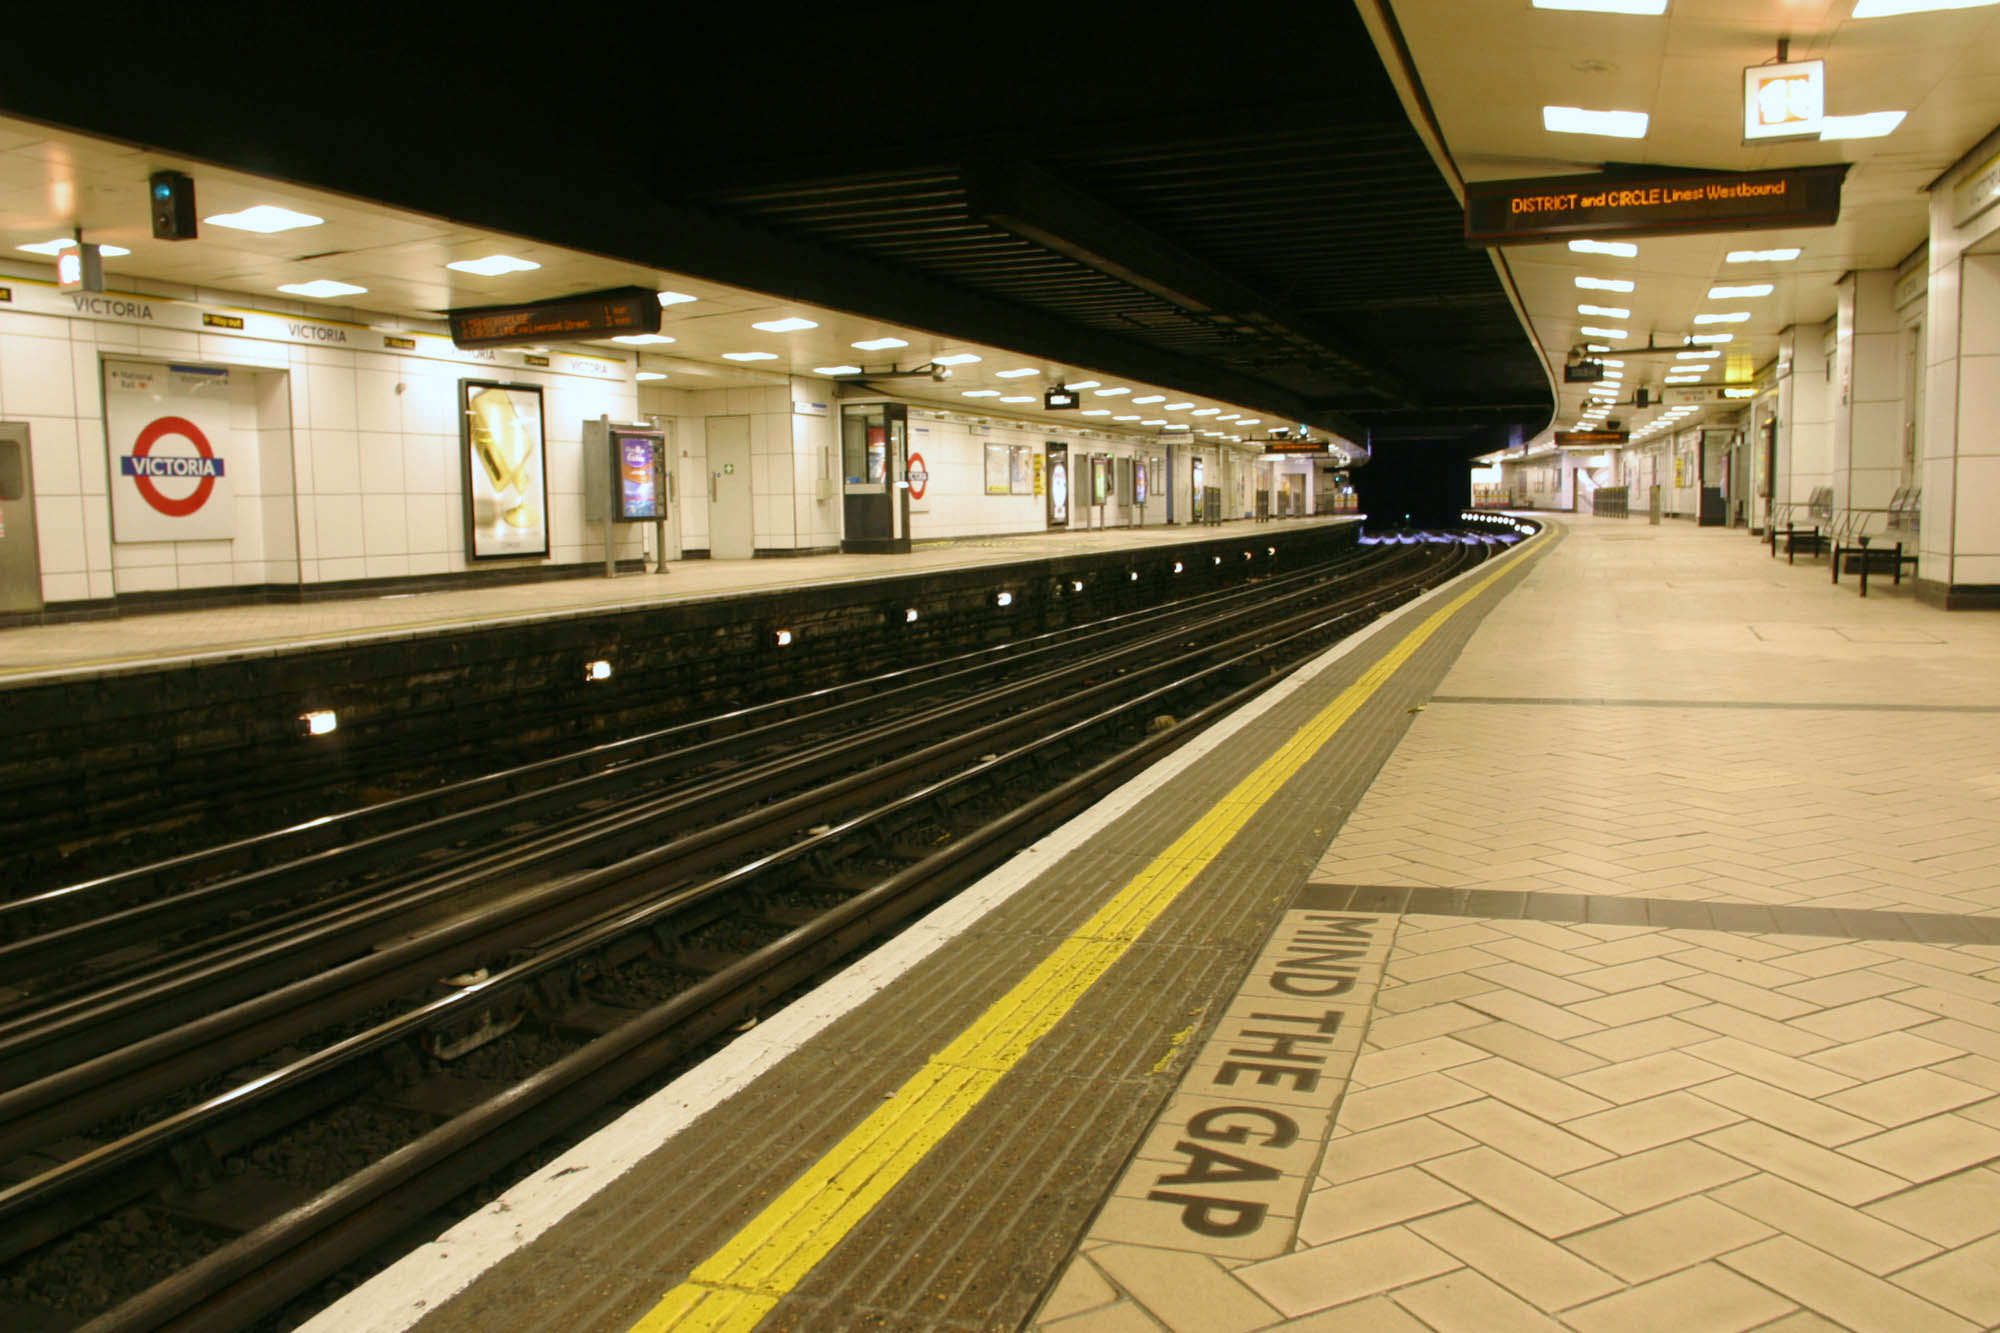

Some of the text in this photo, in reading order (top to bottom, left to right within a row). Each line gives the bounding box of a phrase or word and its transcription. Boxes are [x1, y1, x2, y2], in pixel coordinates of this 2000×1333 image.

[1511, 179, 1786, 213] DISTRICT and CIRCLE Lines: Westbound
[72, 296, 153, 320] VICTORIA
[288, 323, 347, 343] VICTORIA
[131, 457, 217, 476] VICTORIA
[1146, 914, 1379, 1239] MIND THE GAP
